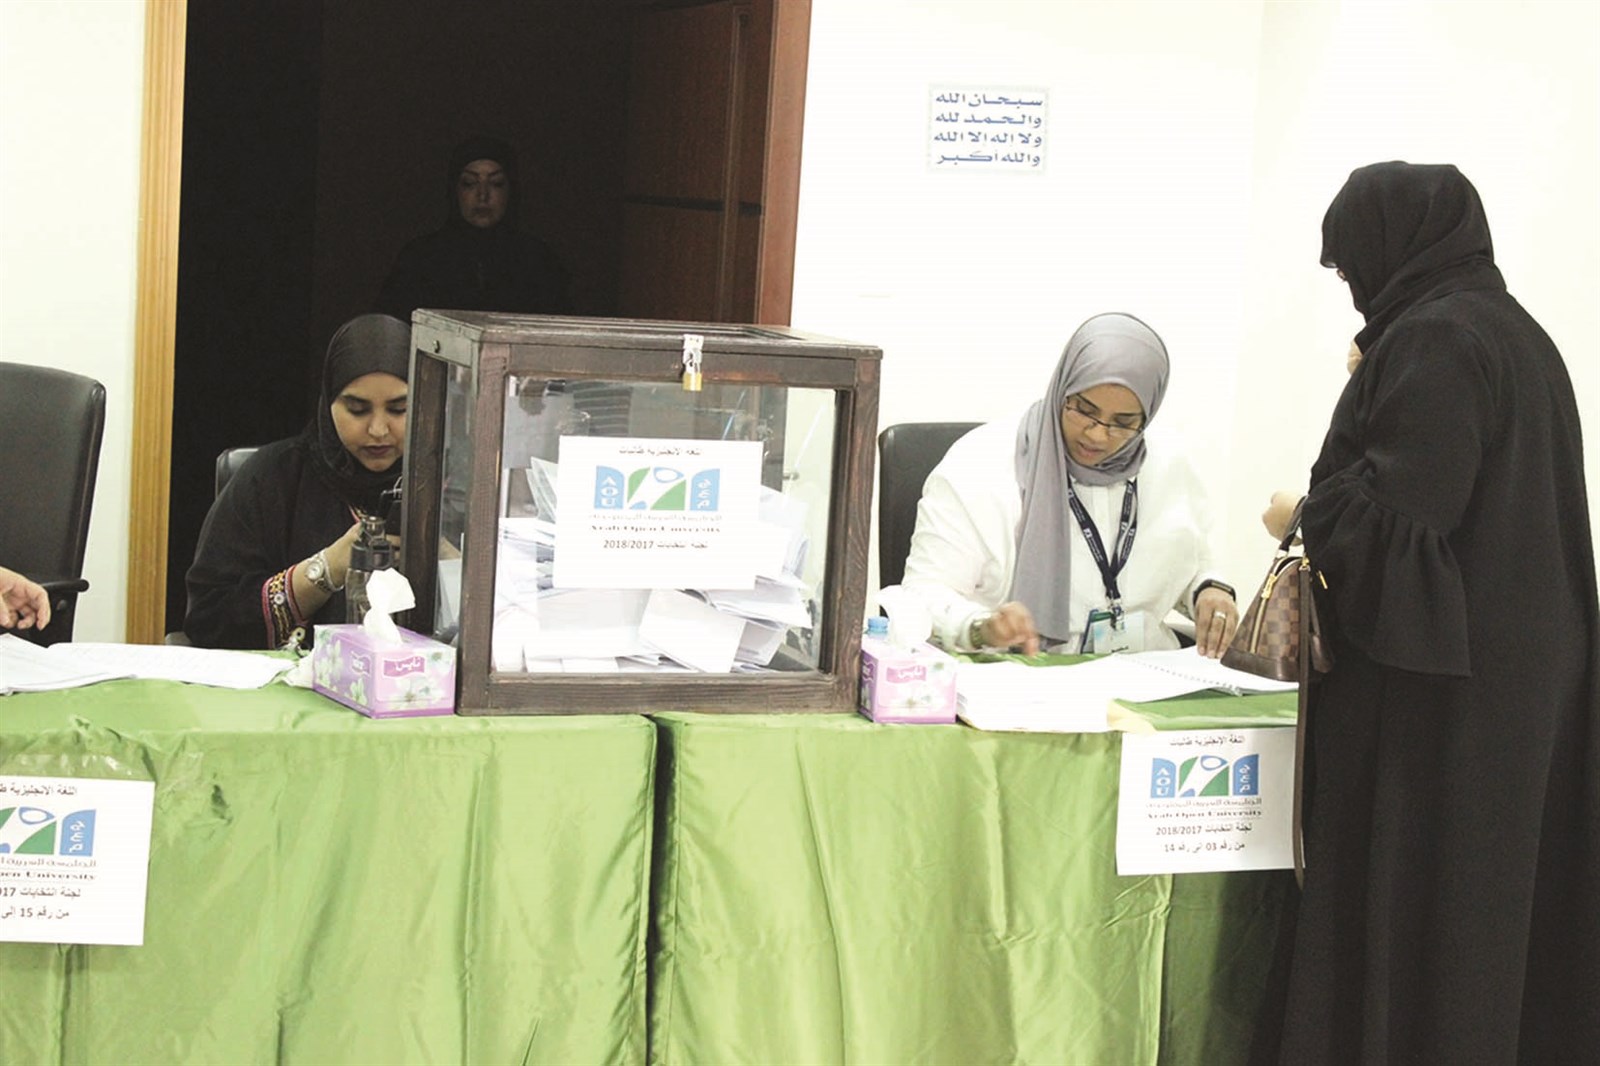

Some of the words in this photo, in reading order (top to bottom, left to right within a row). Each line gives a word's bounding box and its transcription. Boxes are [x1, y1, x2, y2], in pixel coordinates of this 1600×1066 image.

[936, 92, 966, 104] الله
[968, 93, 1043, 109] سبحان
[935, 111, 960, 123] لله
[963, 113, 1042, 129] والحمد
[933, 131, 964, 142] الله
[1017, 132, 1042, 148] ولا
[1000, 152, 1041, 167] والله
[603, 539, 654, 550] 2018/2017
[1155, 825, 1203, 836] 2018/2017
[1205, 842, 1217, 851] 03
[20, 907, 33, 918] 15
[55, 909, 70, 919] من
